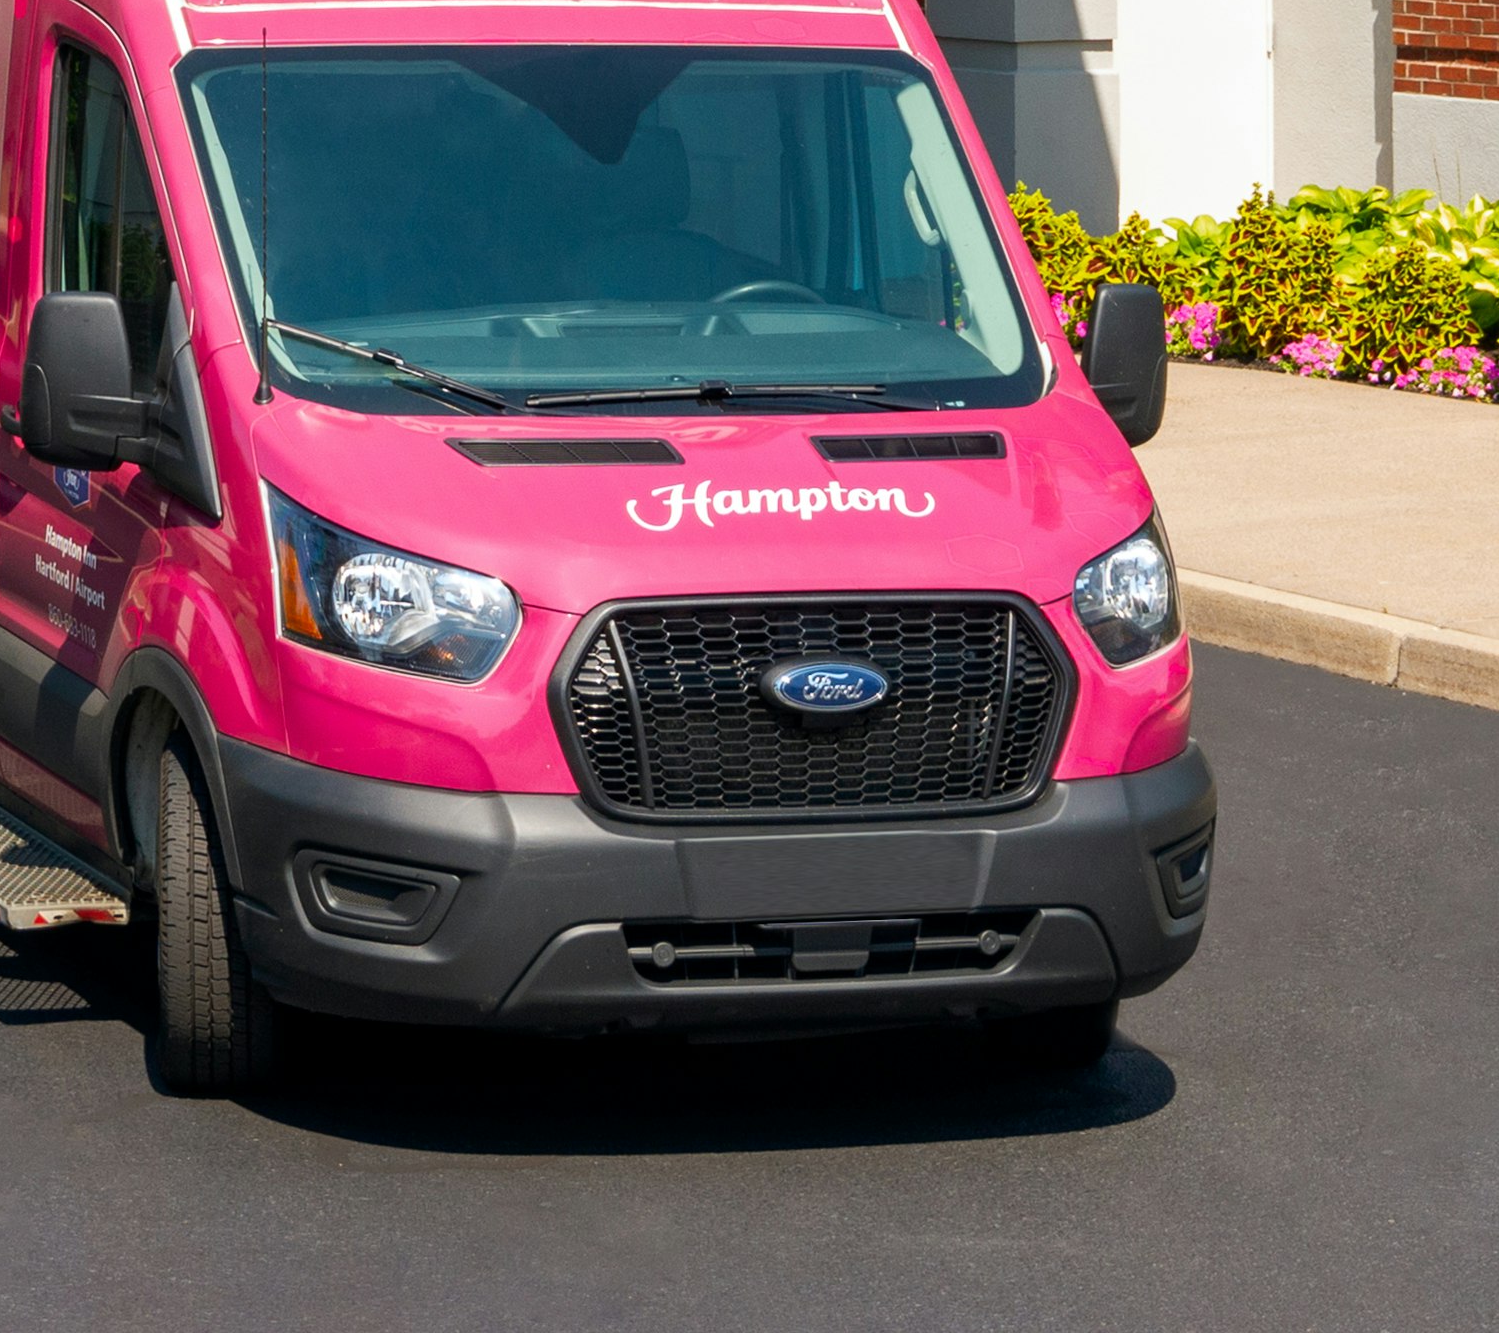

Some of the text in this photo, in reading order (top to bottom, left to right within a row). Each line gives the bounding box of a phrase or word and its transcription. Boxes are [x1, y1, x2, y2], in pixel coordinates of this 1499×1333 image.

[626, 480, 935, 531] Hampton
[45, 524, 97, 570] Hampton Inn
[35, 553, 70, 590] Hartford
[75, 576, 106, 610] Airport
[803, 671, 863, 700] Ford
